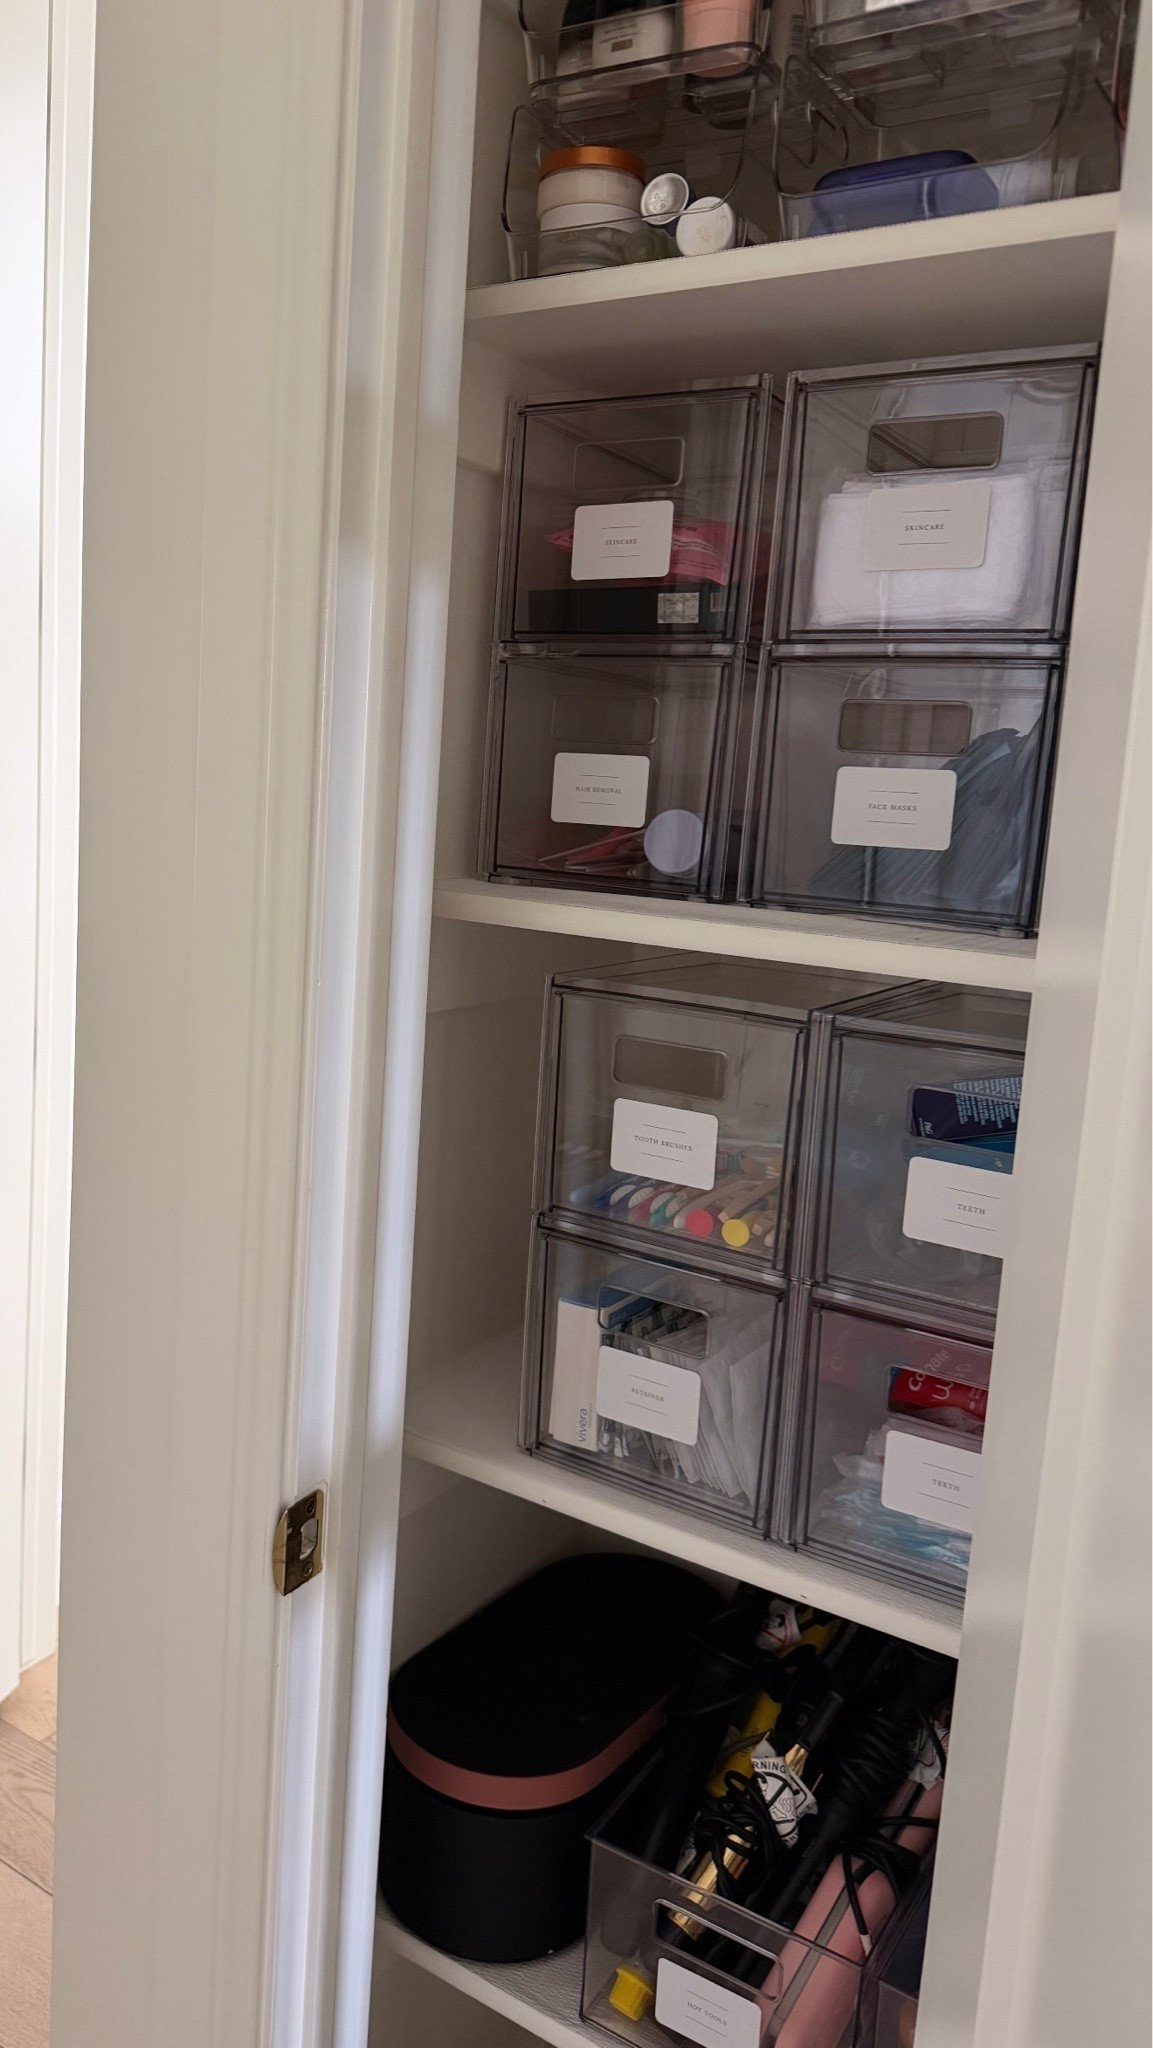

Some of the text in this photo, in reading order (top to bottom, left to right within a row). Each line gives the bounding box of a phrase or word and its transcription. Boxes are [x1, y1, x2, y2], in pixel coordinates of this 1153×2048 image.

[904, 523, 945, 531] SKINCARE
[604, 538, 638, 546] SKINCARE
[592, 786, 623, 794] REMOVAL
[634, 1135, 693, 1151] TOOTH BRUSHES
[956, 1203, 986, 1215] TEETH
[631, 1387, 664, 1401] RETAINER
[578, 1408, 588, 1442] vivera
[932, 1478, 960, 1491] TEETH
[753, 1760, 787, 1774] RNING
[687, 2001, 728, 2026] HOT TOOLS
